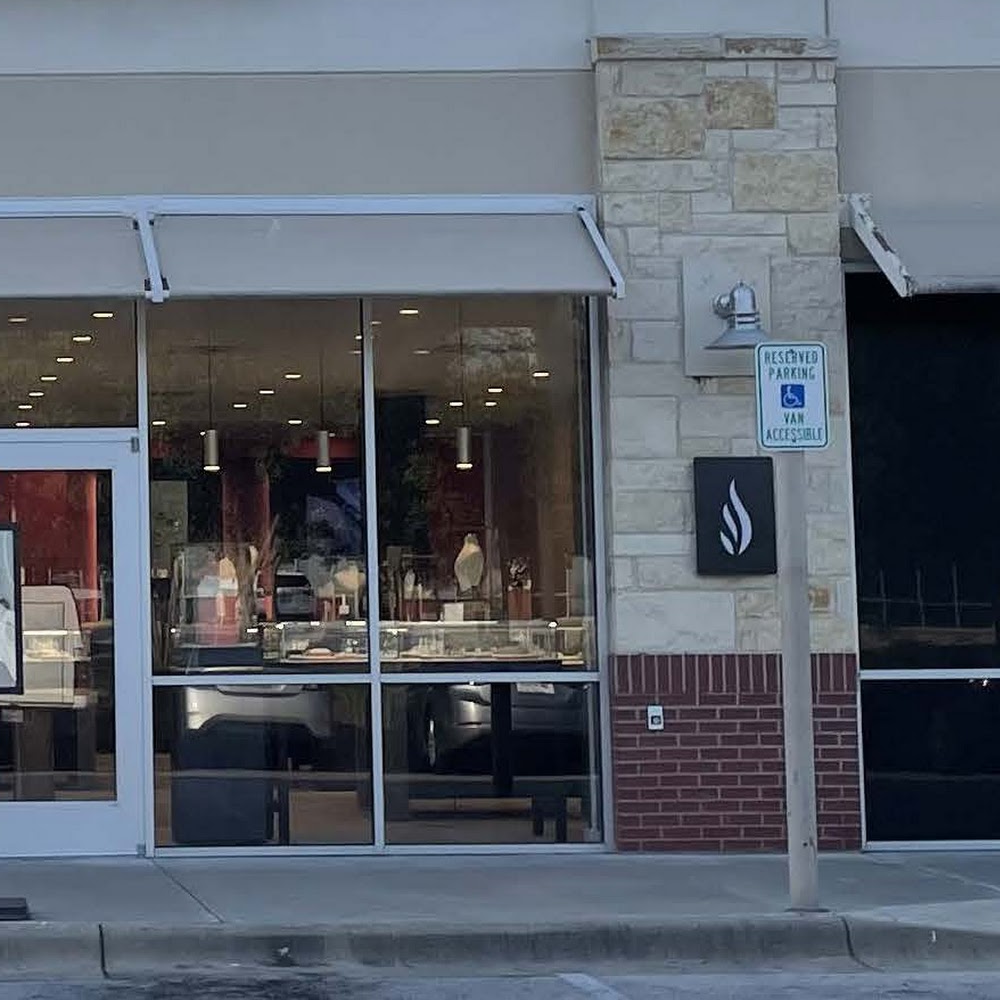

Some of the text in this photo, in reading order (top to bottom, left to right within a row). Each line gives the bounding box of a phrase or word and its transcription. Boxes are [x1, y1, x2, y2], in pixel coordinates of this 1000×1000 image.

[764, 350, 818, 364] RESERVED
[769, 367, 815, 380] PARKING
[784, 412, 804, 424] VAN
[766, 428, 823, 441] ACCESSIBLE
